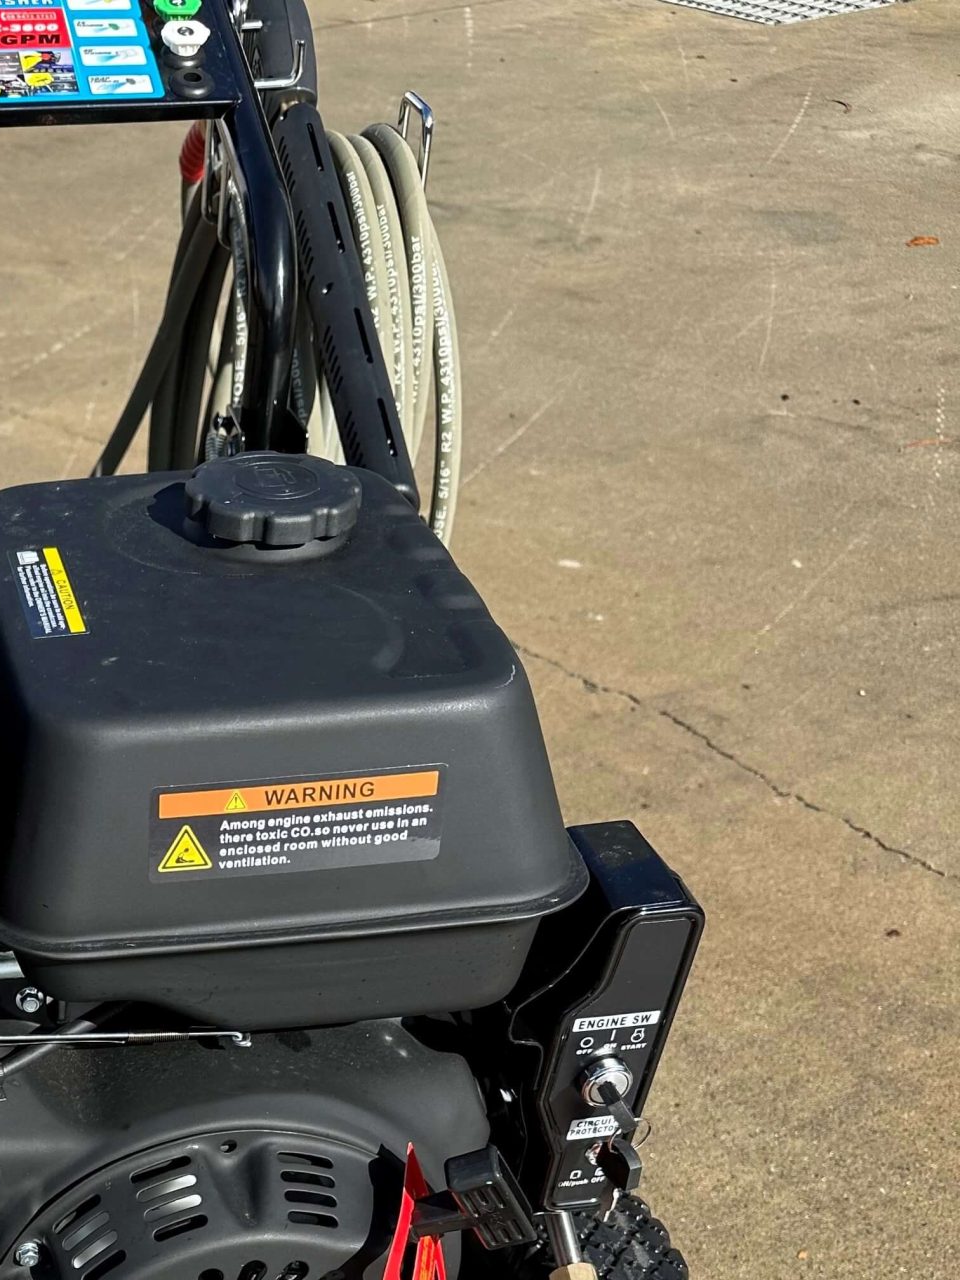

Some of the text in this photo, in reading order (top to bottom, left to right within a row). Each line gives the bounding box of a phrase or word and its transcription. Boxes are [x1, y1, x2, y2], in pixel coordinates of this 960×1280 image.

[432, 505, 447, 539] OSE.
[441, 431, 452, 453] R2
[55, 579, 74, 610] CAUTION
[264, 781, 375, 806] WARNING
[219, 803, 434, 831] Among engine exhaust emissions.
[219, 832, 253, 844] there
[255, 828, 289, 841] toxic
[332, 822, 369, 834] never
[371, 820, 395, 830] use
[396, 817, 409, 828] in
[411, 816, 428, 827] an
[218, 829, 409, 857] enclosed room without good
[218, 855, 291, 869] ventilation.
[578, 1013, 652, 1030] ENGINE SW
[620, 1042, 648, 1051] START
[576, 1118, 615, 1128] CIRCUI
